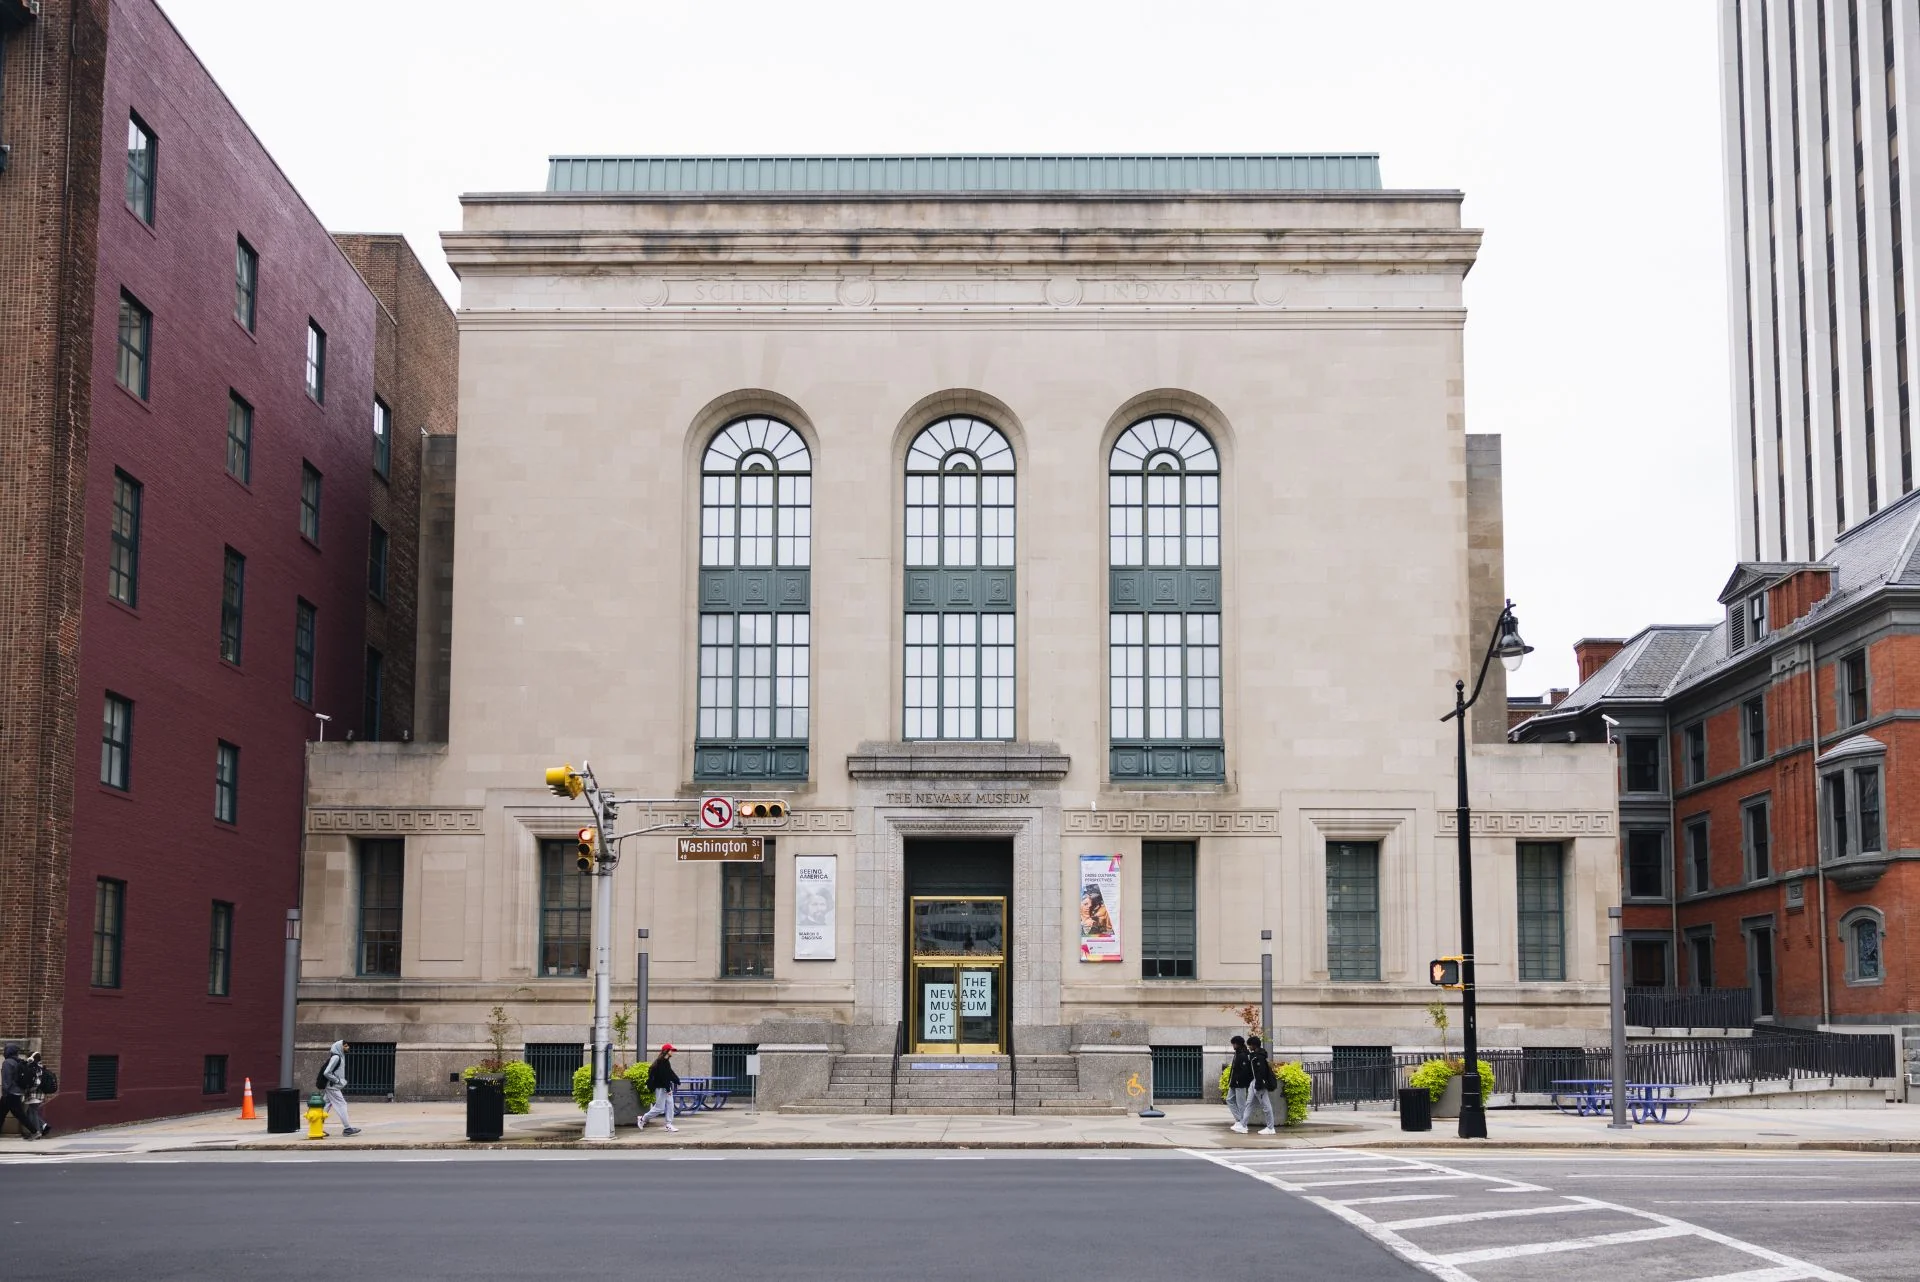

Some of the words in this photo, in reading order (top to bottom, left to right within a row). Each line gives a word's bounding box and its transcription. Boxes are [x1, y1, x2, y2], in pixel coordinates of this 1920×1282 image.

[694, 284, 809, 301] SCIENCE
[938, 284, 985, 301] ART
[886, 792, 912, 804] THE
[915, 792, 972, 804] NEWARK
[975, 792, 1031, 804] MUSEUM
[680, 840, 748, 857] Washington
[964, 977, 987, 987] THE
[930, 1001, 987, 1011] MUSEUM
[929, 1013, 946, 1023] OF
[929, 1025, 955, 1035] ART
